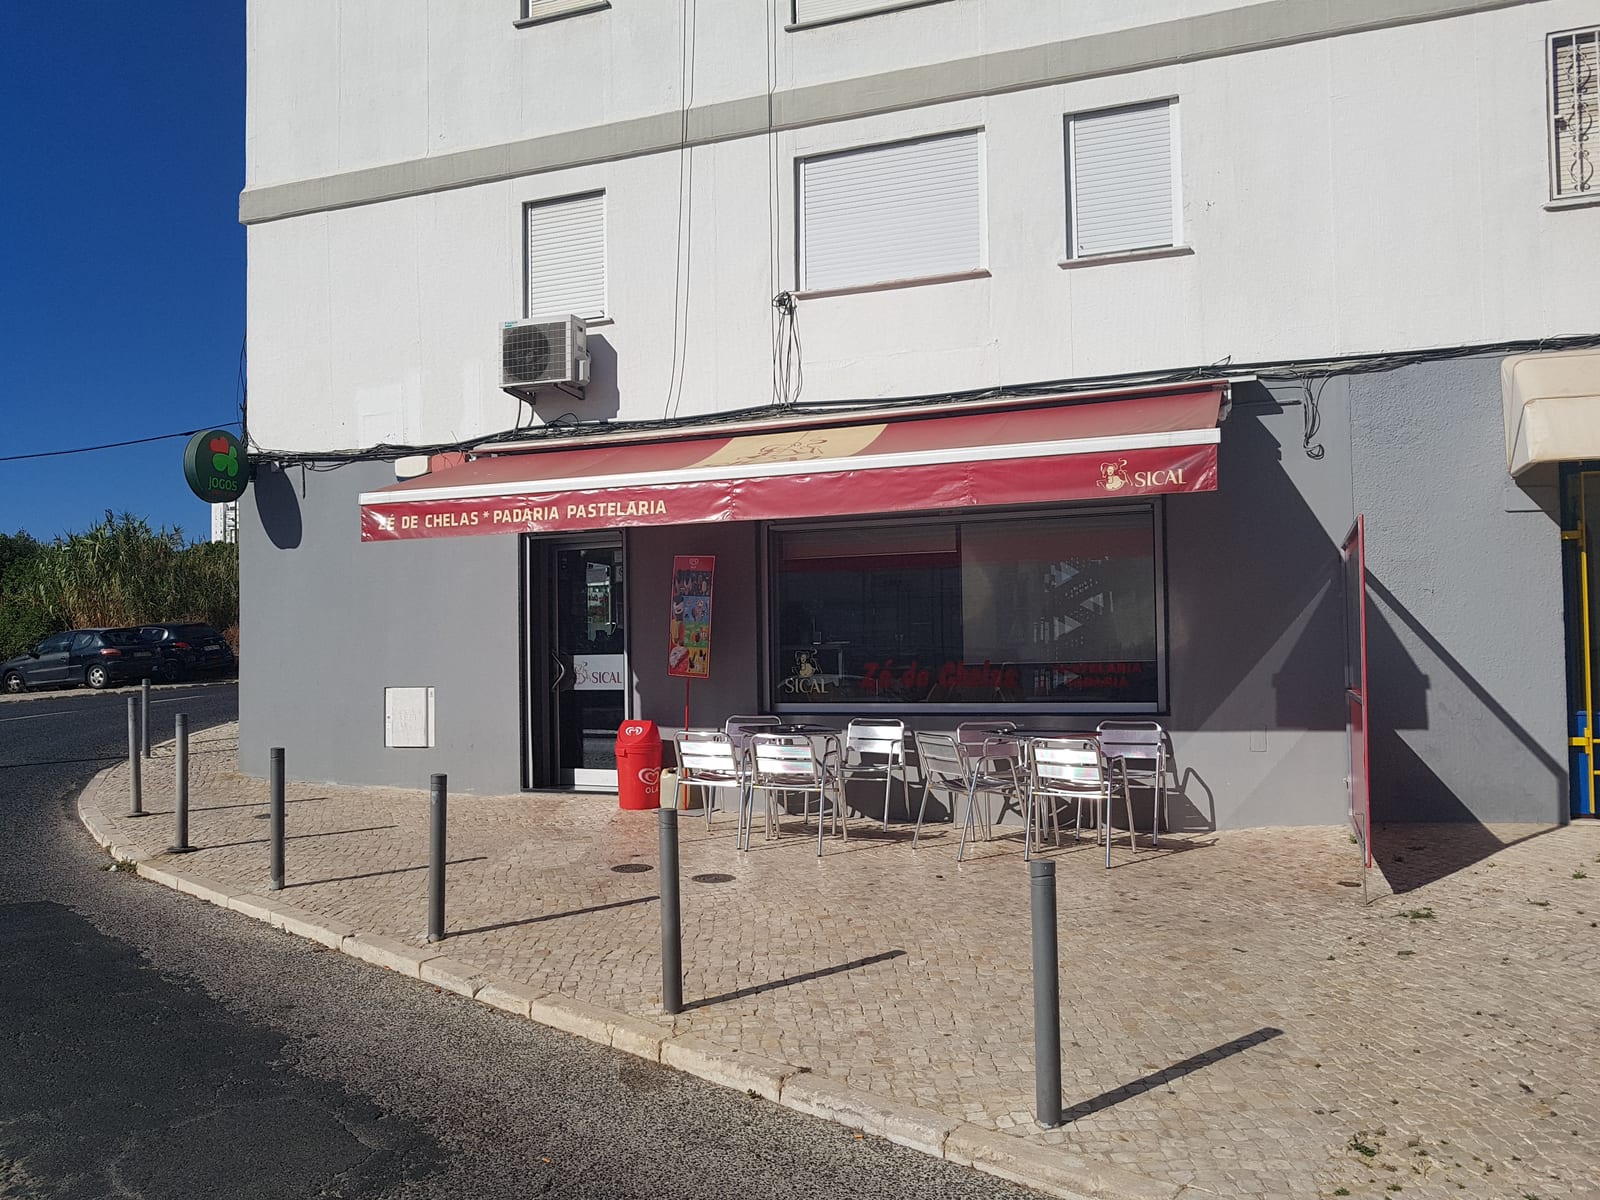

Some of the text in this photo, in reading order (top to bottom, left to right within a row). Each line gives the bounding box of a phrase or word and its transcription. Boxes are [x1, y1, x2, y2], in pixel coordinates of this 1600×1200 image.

[208, 476, 237, 490] JOGOS
[1134, 469, 1187, 487] SICAL
[401, 515, 418, 529] DE
[425, 511, 478, 528] CHELAS
[493, 506, 559, 523] PADARIA
[567, 500, 667, 519] PASTELARIA
[591, 671, 623, 684] SICAL
[784, 678, 829, 694] SICAL
